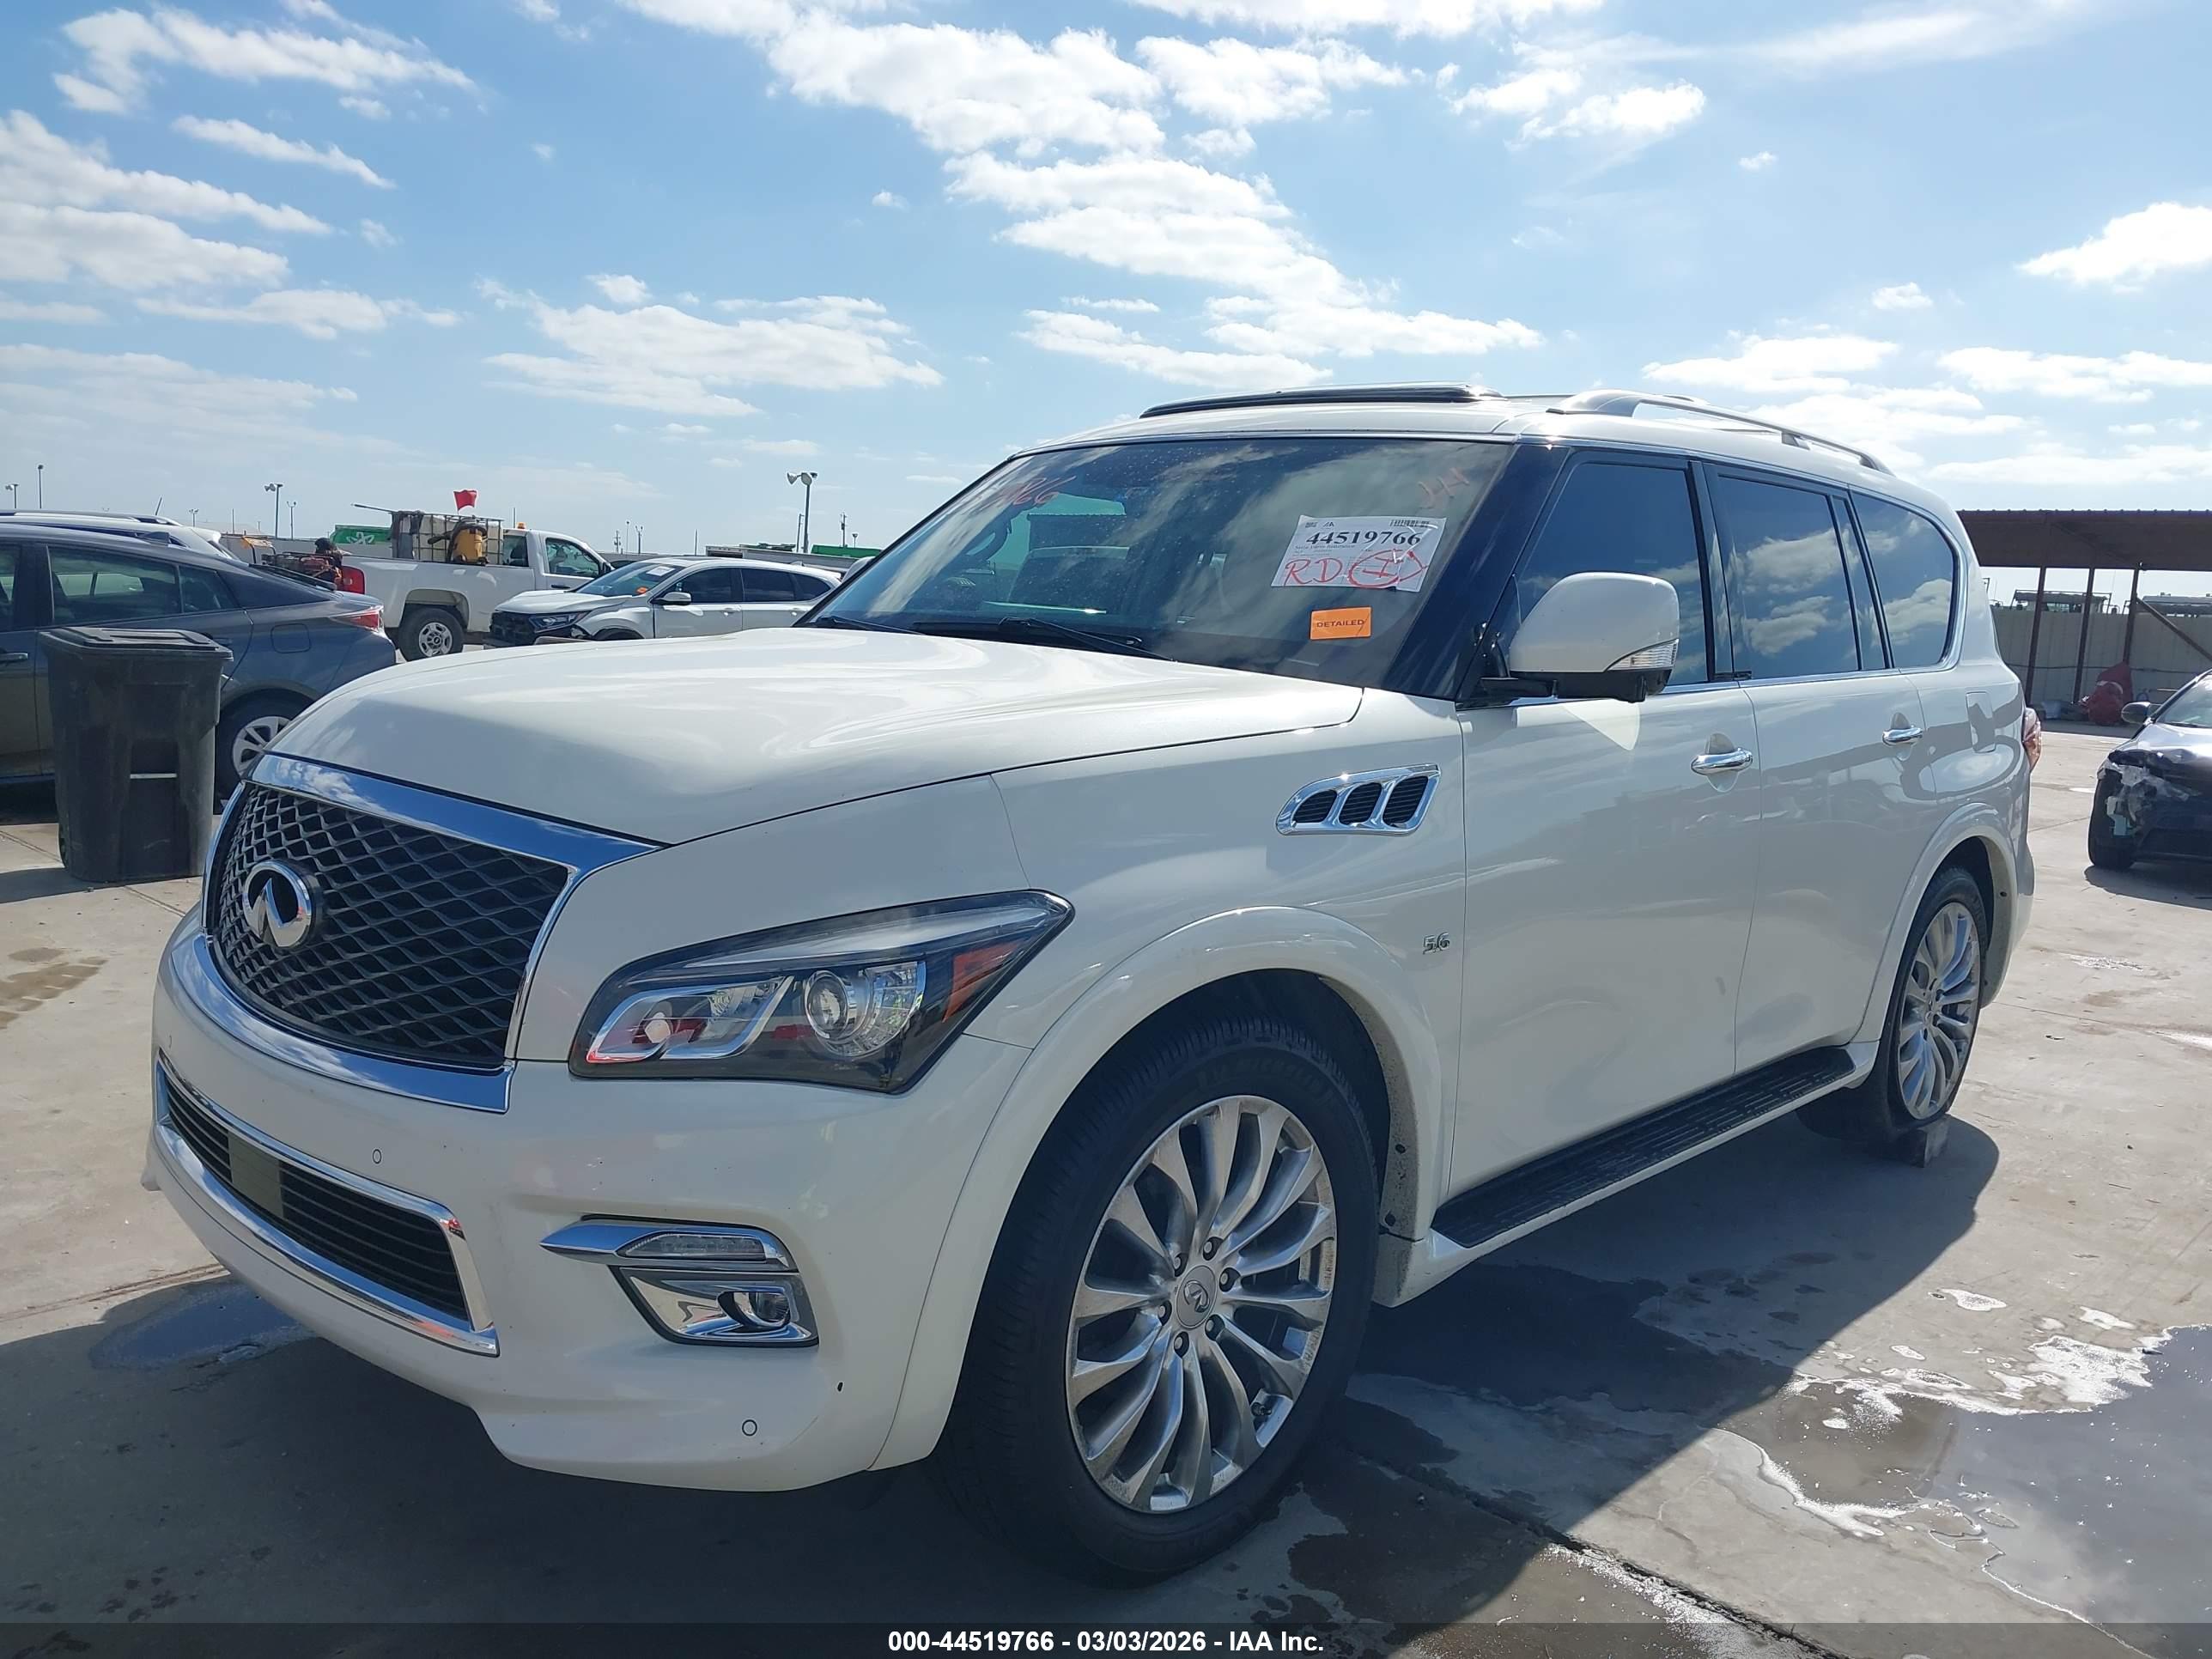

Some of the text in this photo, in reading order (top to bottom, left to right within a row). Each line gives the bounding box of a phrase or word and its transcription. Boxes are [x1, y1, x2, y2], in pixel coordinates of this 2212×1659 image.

[1306, 532, 1421, 545] 44519766
[1285, 558, 1343, 585] RD
[1316, 618, 1364, 628] DETAILED
